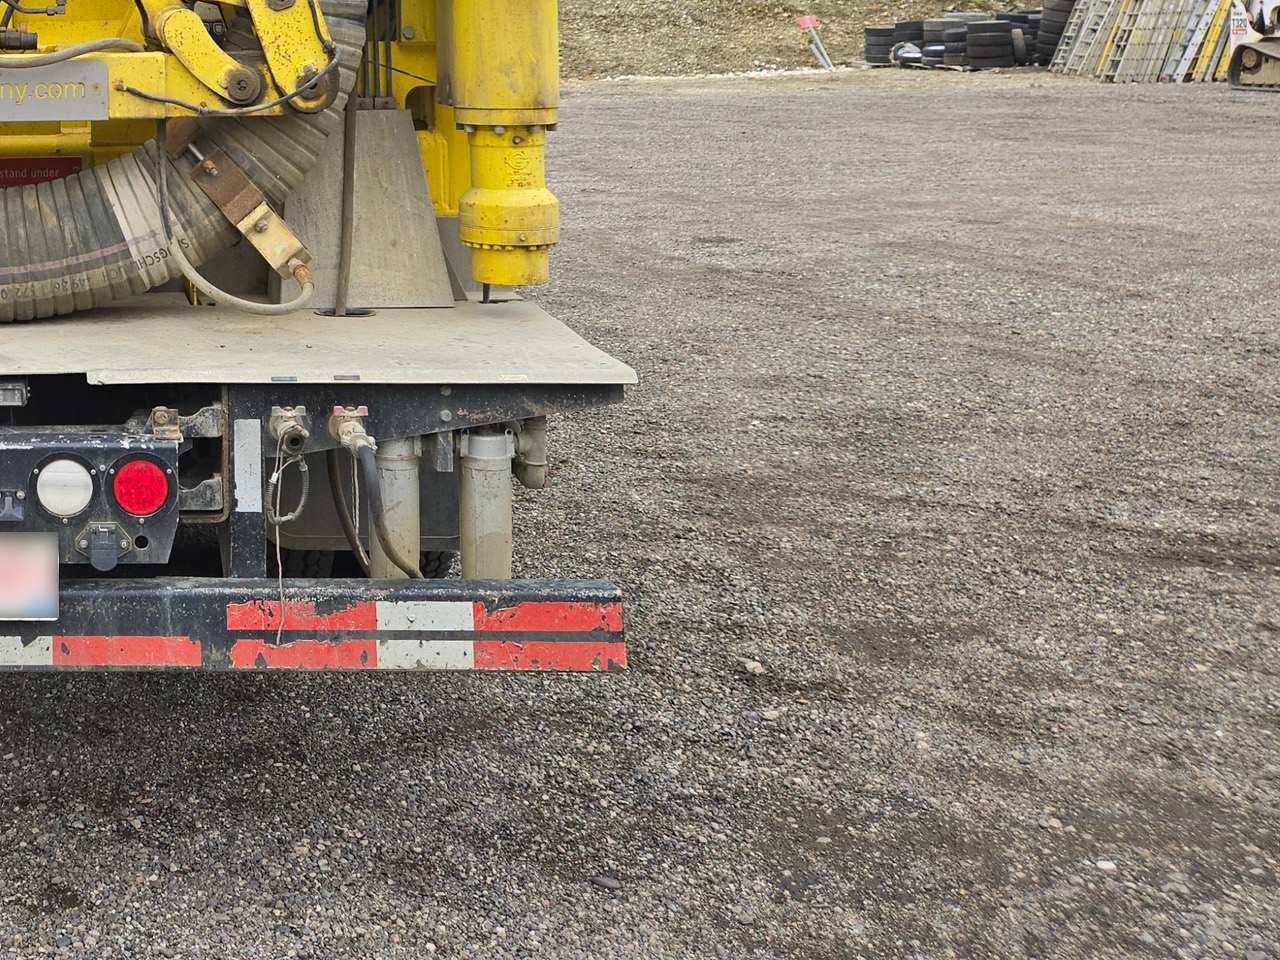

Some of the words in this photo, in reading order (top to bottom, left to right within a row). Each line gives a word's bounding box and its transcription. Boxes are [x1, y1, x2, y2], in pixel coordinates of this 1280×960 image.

[1232, 18, 1248, 29] T320
[0, 167, 27, 179] stand
[31, 167, 60, 178] under
